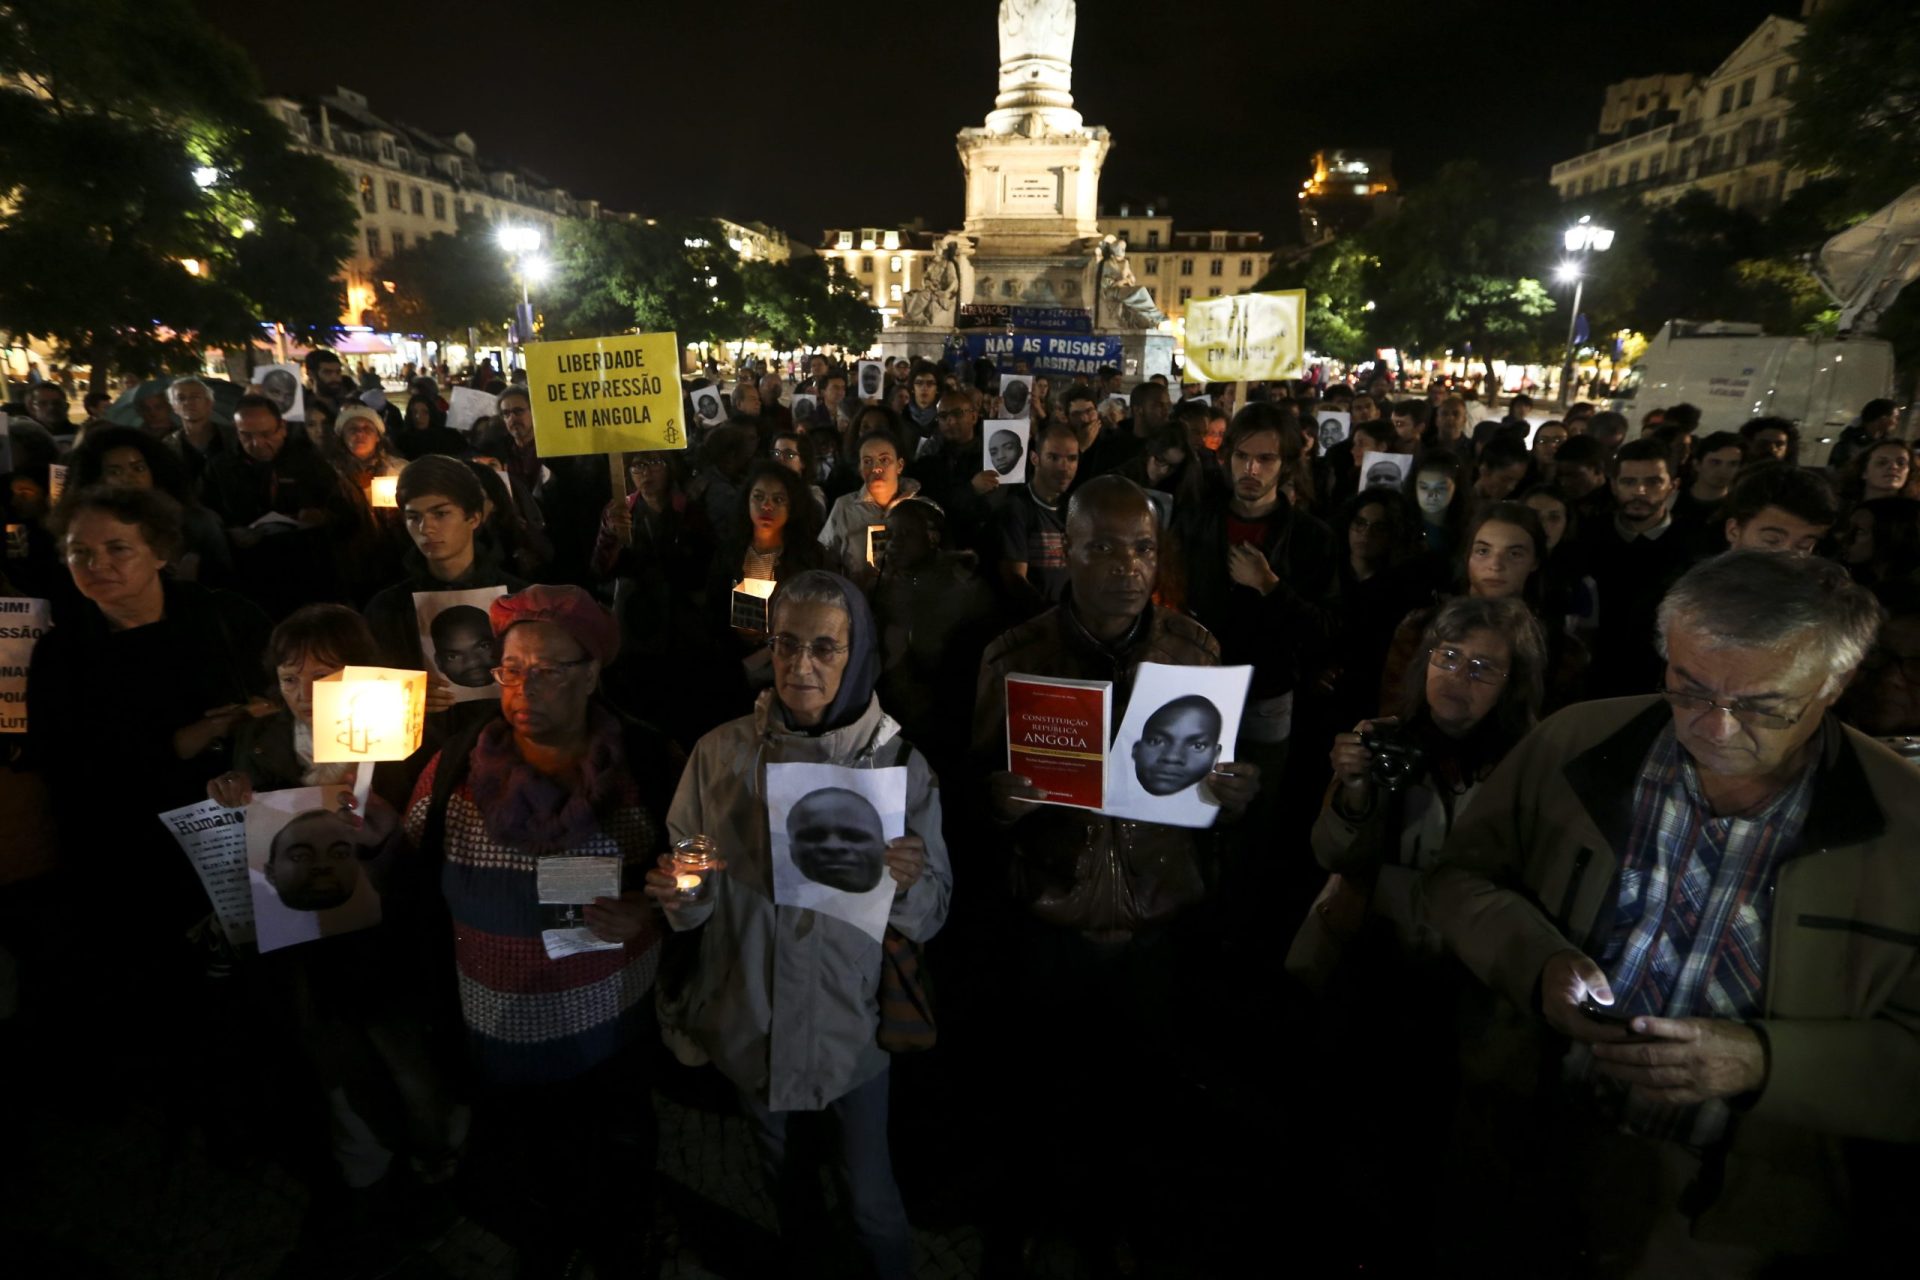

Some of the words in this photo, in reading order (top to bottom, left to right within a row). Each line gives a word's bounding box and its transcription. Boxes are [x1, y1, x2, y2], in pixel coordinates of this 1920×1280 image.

[557, 349, 645, 373] LIBERDADE
[547, 384, 568, 402] DE
[572, 373, 662, 401] EXPRESSÃO
[564, 410, 587, 429] EM
[591, 405, 651, 427] ANGOLA
[1022, 713, 1088, 727] CONSTITUIÇÃO
[1024, 732, 1087, 749] ANGOLA
[173, 809, 248, 836] Humano
